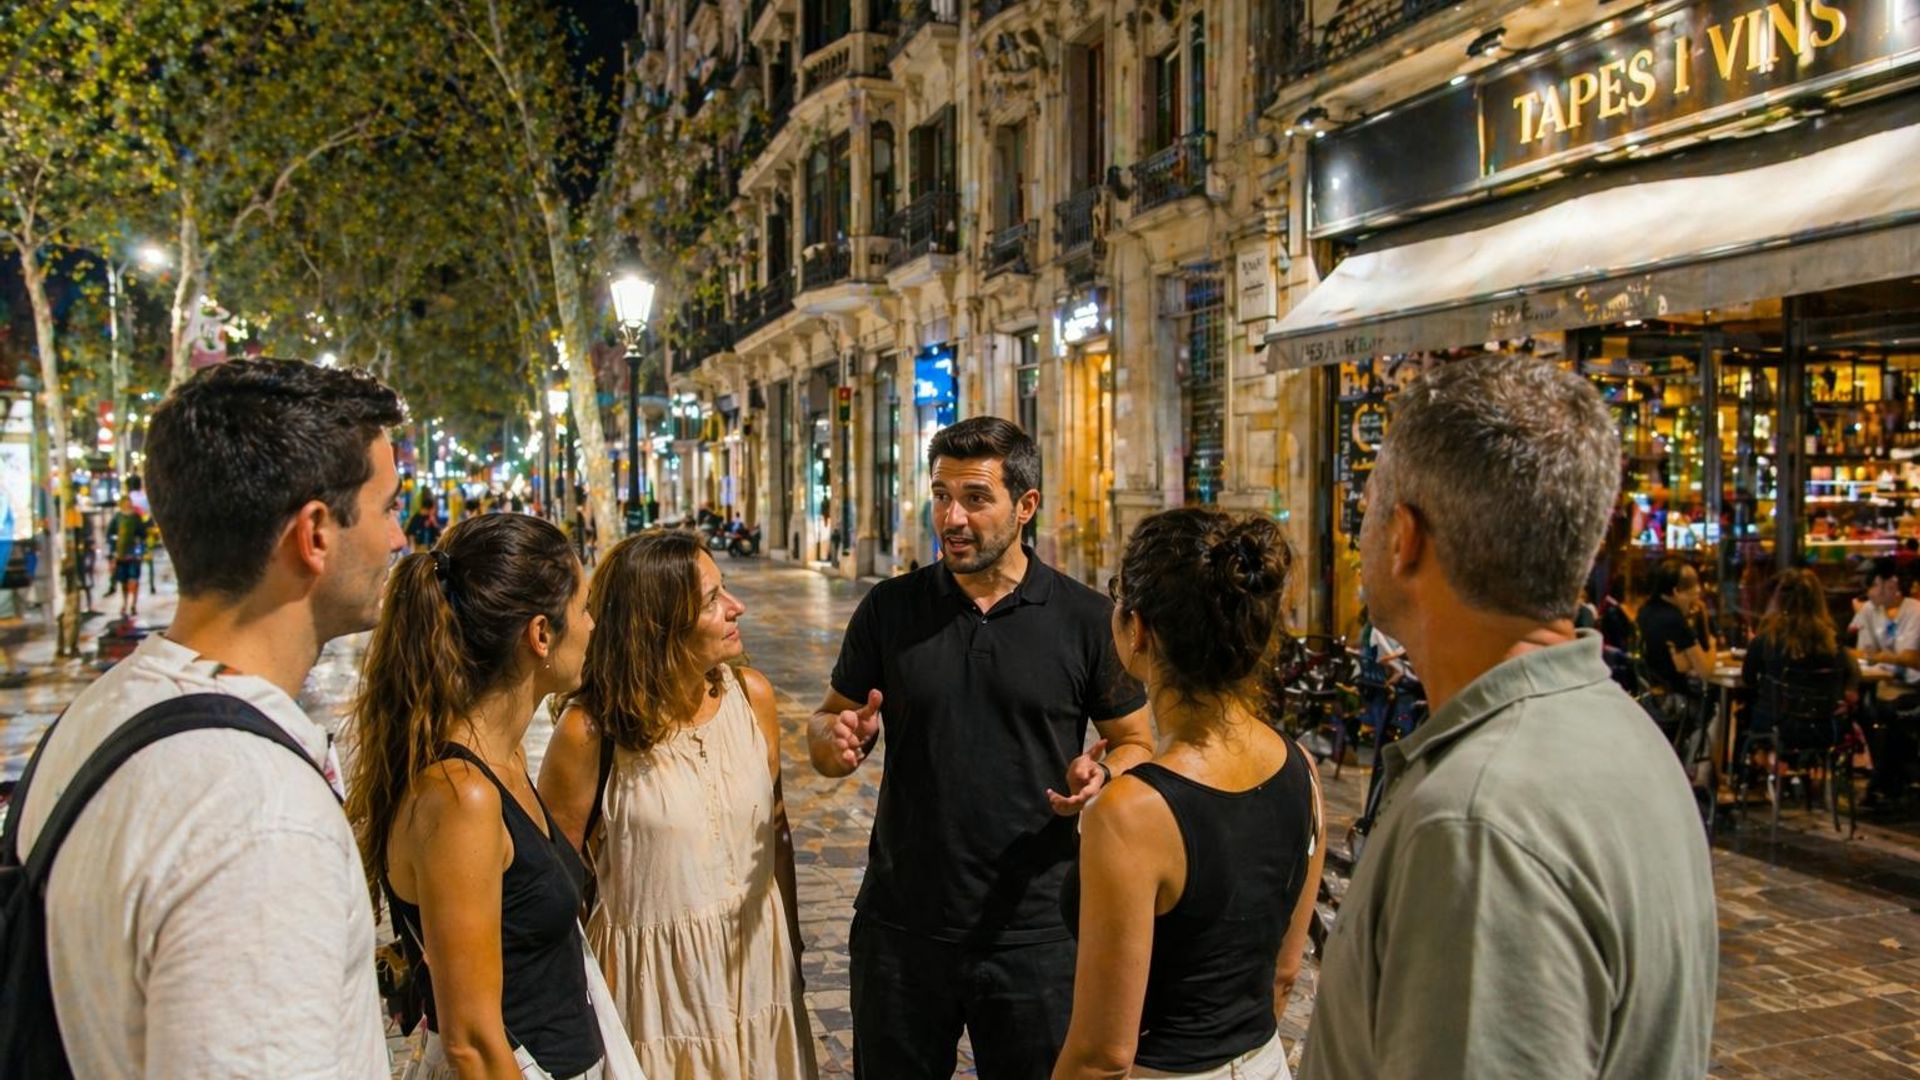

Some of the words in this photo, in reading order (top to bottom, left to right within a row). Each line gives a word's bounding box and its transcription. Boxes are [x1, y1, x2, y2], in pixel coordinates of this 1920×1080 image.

[1513, 49, 1656, 144] TAPES
[1673, 35, 1690, 95] I
[1706, 0, 1847, 81] VINS
